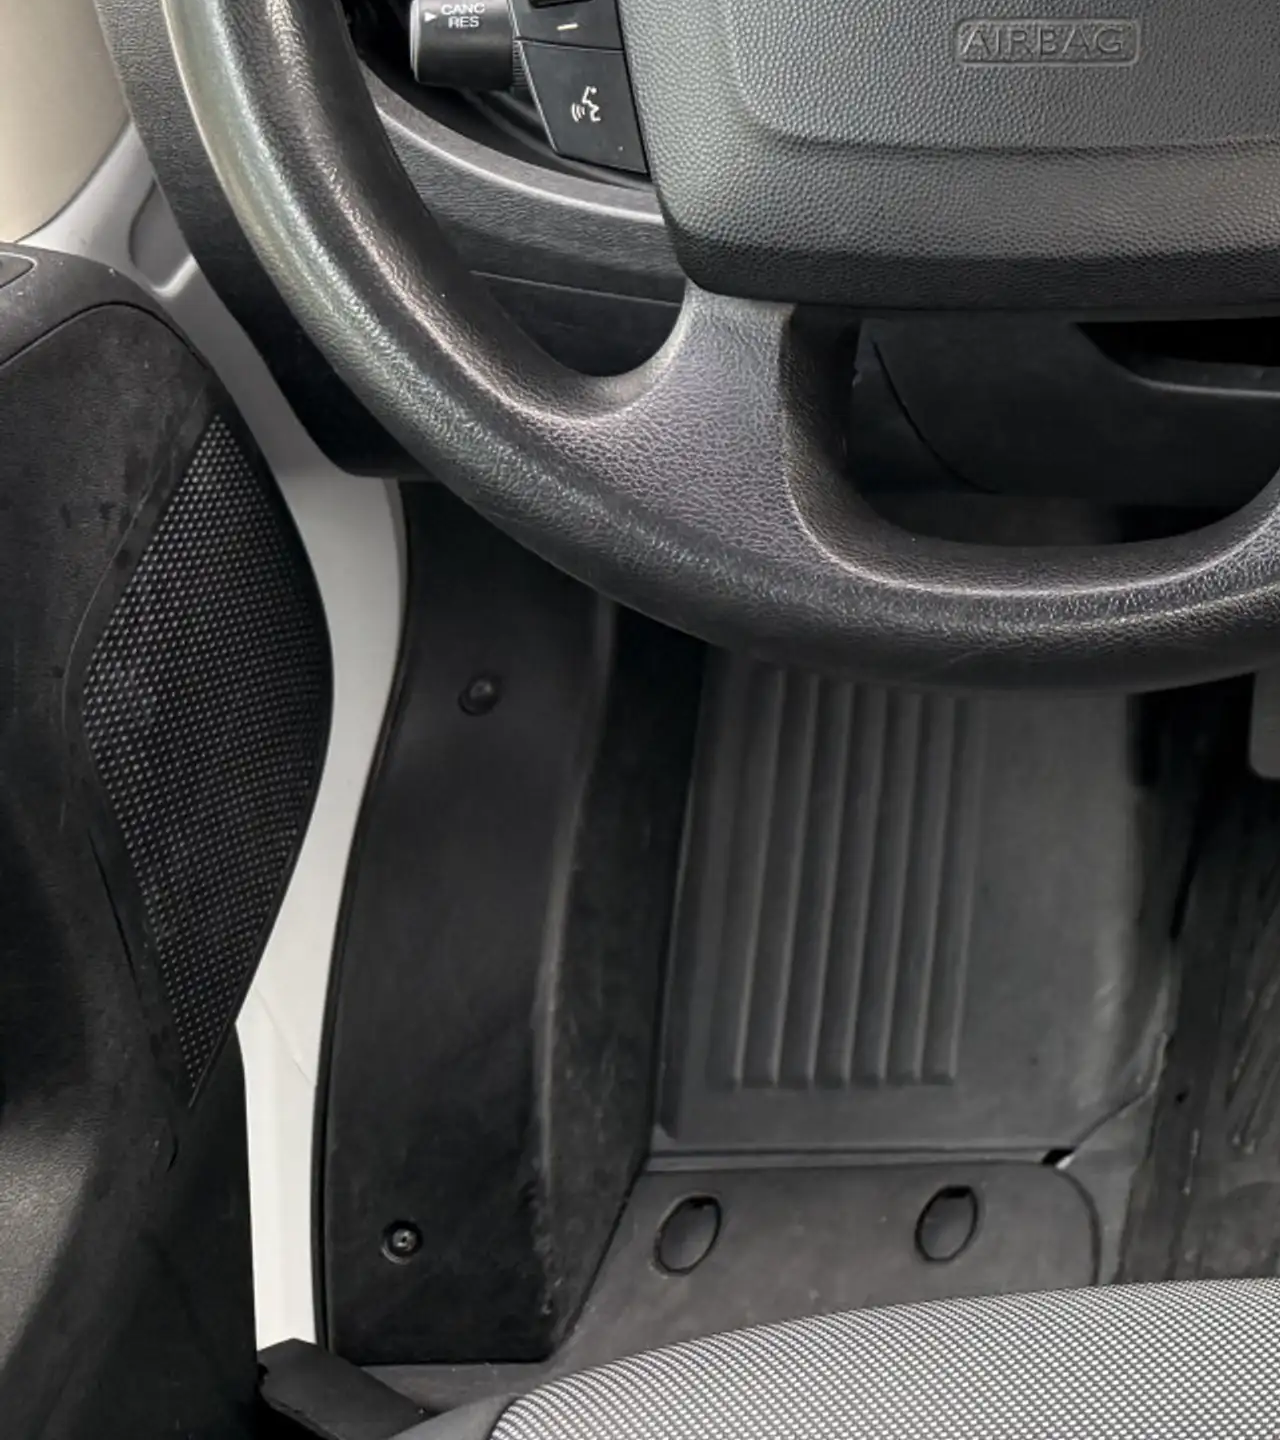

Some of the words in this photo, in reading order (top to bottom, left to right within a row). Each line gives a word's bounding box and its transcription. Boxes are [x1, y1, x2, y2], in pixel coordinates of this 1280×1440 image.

[441, 2, 486, 16] CANC
[448, 16, 480, 28] RES
[962, 27, 1123, 56] AIRBAG
